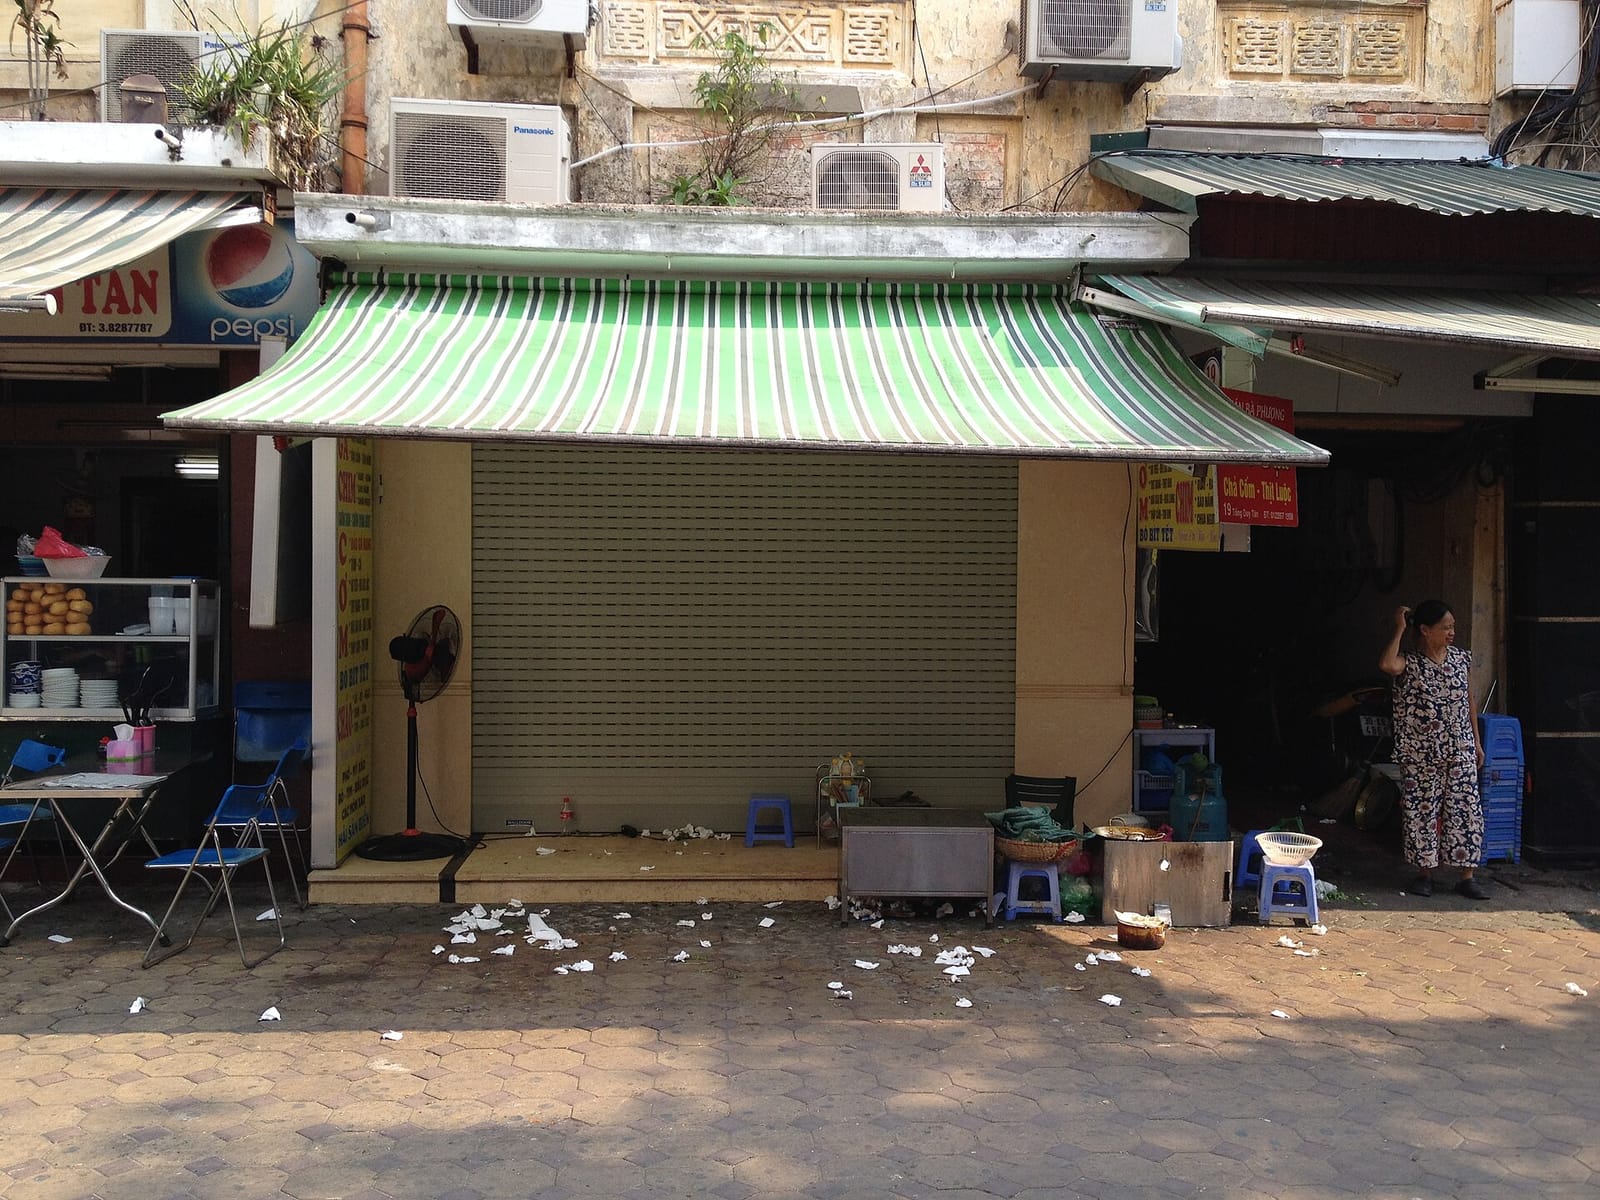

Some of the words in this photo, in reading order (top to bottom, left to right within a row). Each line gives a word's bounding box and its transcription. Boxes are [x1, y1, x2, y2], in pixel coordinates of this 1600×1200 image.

[513, 126, 554, 135] Panasonic
[79, 322, 96, 332] ĐT:
[98, 323, 153, 333] 3.8287787
[210, 314, 295, 341] pepsi
[1223, 502, 1232, 516] 19
